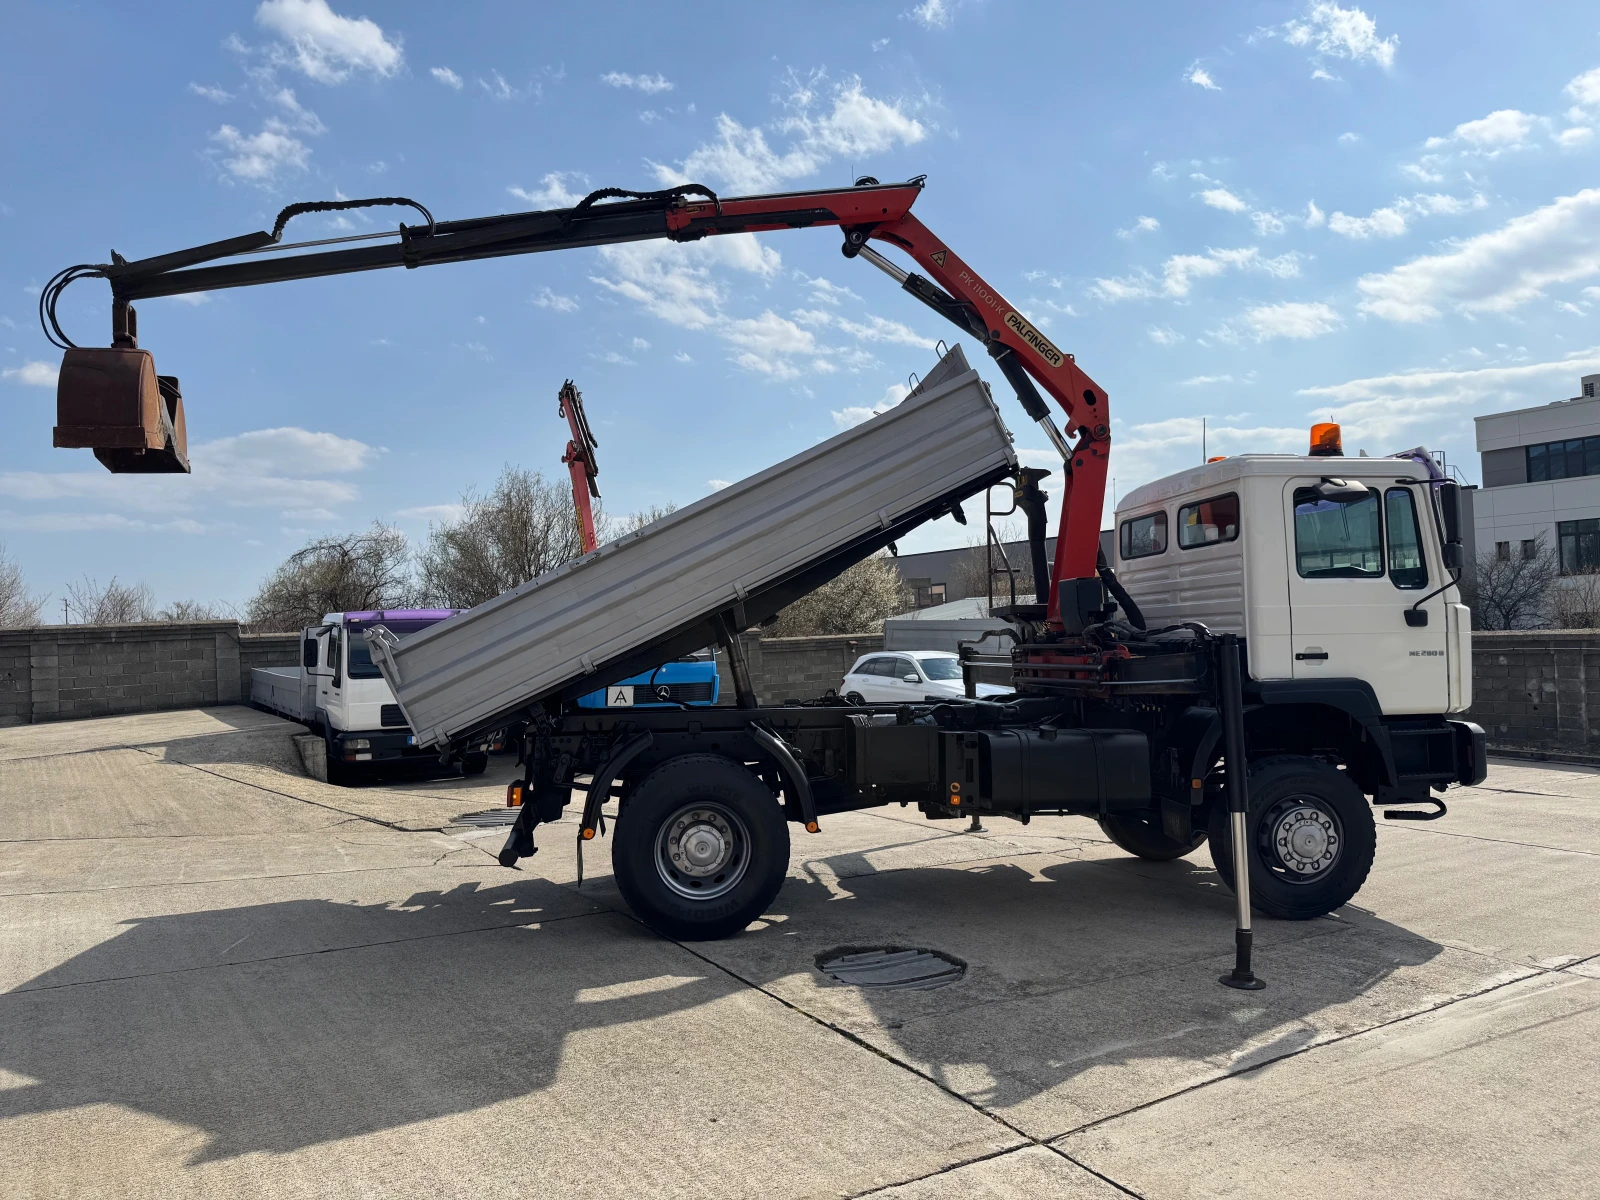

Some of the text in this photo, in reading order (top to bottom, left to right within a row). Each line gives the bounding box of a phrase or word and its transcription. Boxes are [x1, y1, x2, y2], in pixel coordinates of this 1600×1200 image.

[959, 271, 974, 287] PK
[1007, 314, 1061, 365] PALFINGER
[613, 689, 627, 704] A
